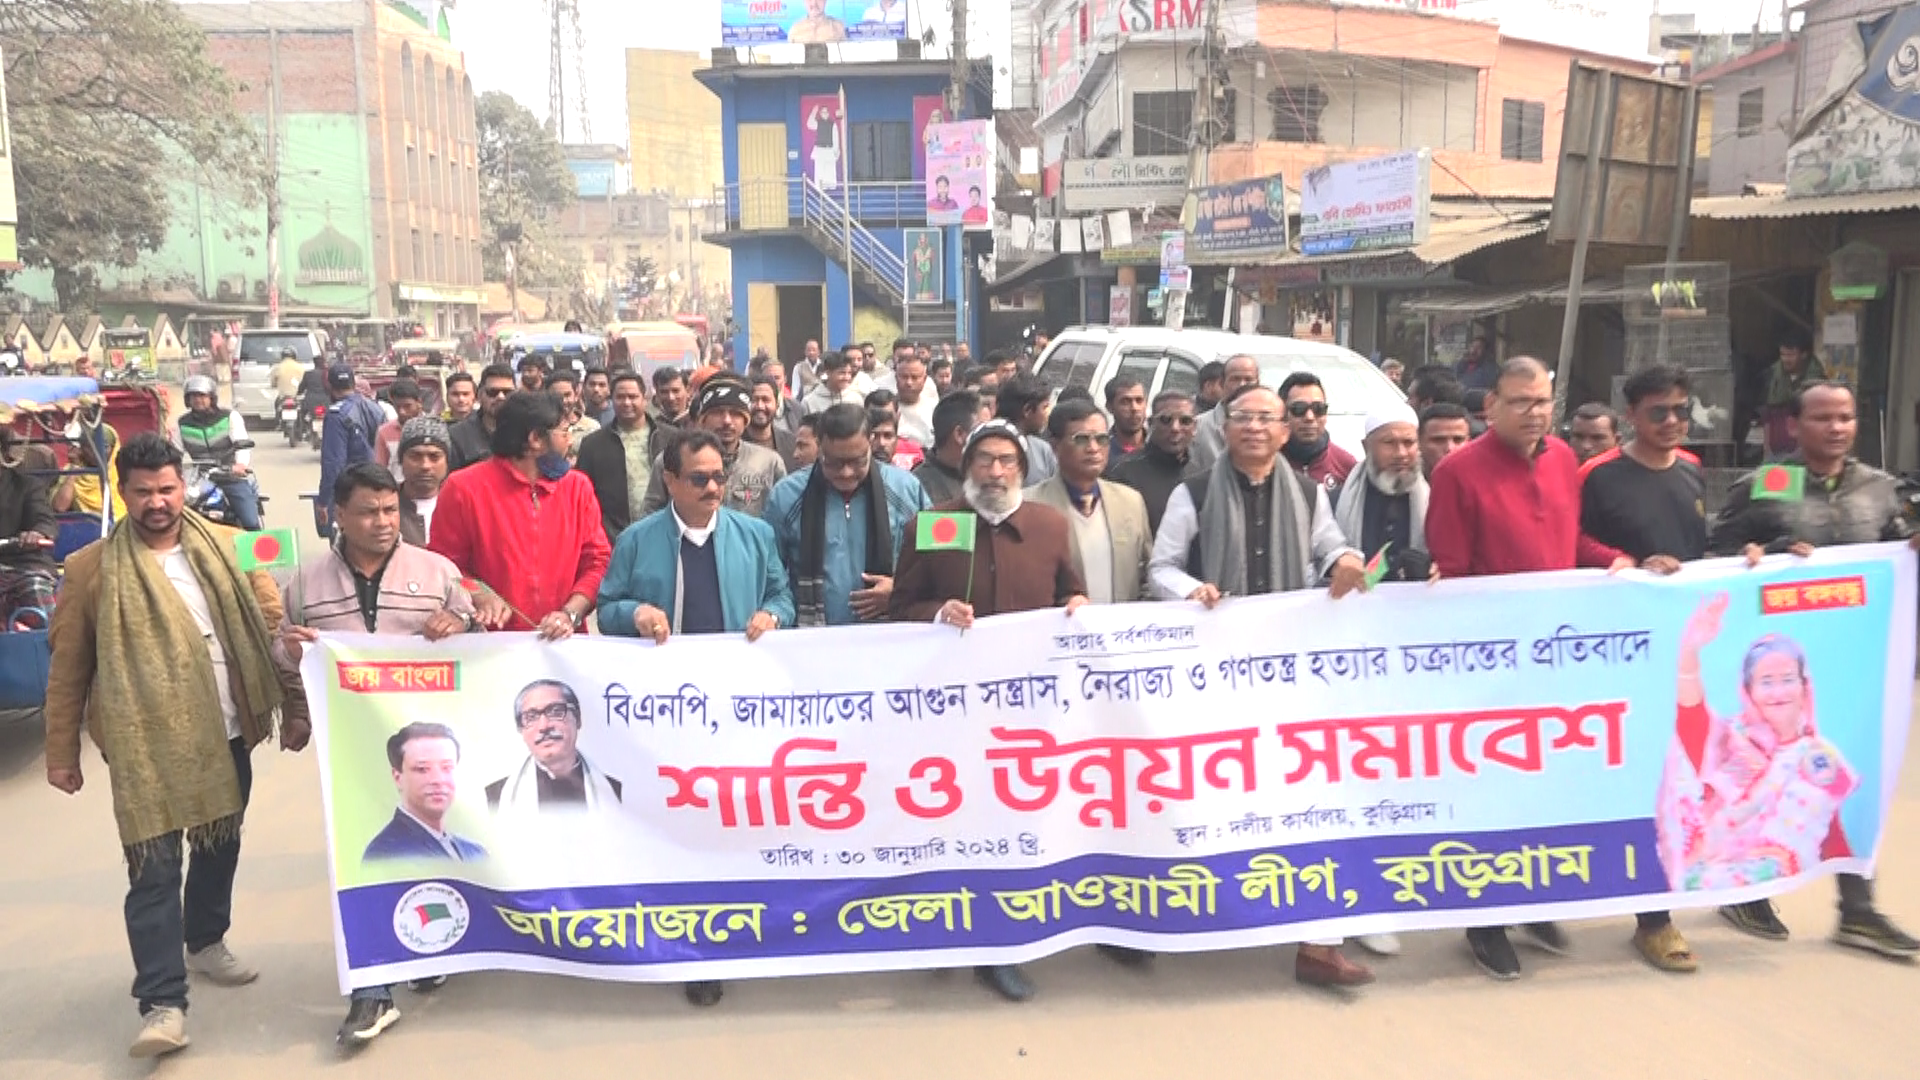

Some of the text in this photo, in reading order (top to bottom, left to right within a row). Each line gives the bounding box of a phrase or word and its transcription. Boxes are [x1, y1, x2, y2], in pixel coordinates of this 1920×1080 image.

[343, 664, 451, 689] জয় বাংলা
[602, 625, 1650, 735] বিএনপি, জামায়াতের আগুন সন্ত্রাস, নৈরাজ্য ও গণতন্ত্র হত্যার চক্রান্তের প্রতিবাদে
[657, 701, 1628, 830] শান্তি ও উন্নয়ন সমাবেশ
[760, 843, 814, 867] তারিখ
[836, 850, 866, 865] ৩০
[872, 836, 947, 867] জানুয়ারি
[955, 838, 1010, 856] ২০২৪
[1172, 824, 1208, 848] স্থান
[1228, 811, 1273, 833] দলীয়
[1278, 804, 1355, 829] কার্যালয়,
[1360, 798, 1437, 827] কুড়িগ্রাম
[494, 901, 768, 948] আয়োজনে
[837, 886, 976, 933] জেলা
[992, 863, 1221, 920] আওয়ামী
[1236, 853, 1359, 908] লীগ,
[1374, 841, 1594, 907] কুড়িগ্রাম
